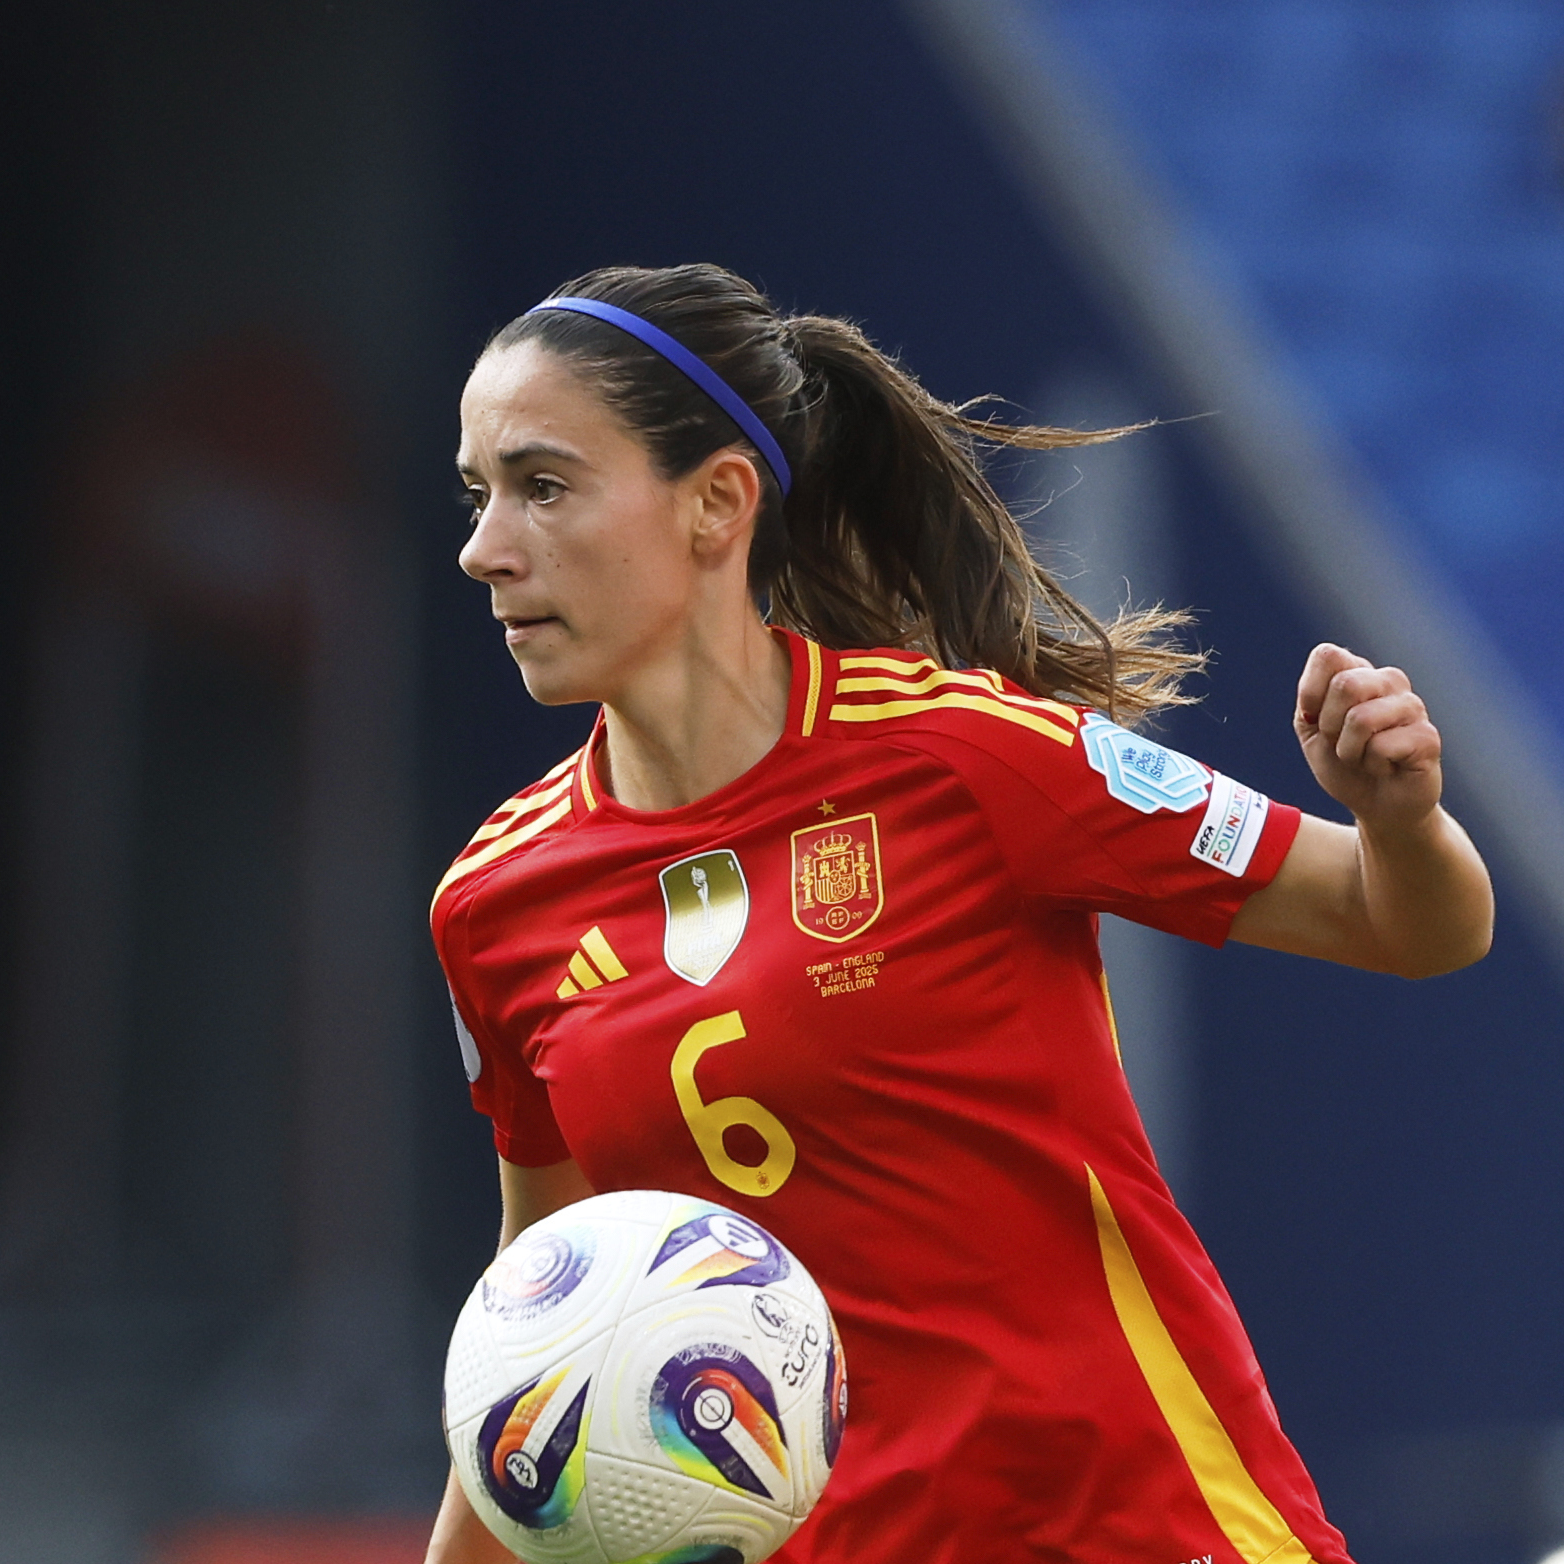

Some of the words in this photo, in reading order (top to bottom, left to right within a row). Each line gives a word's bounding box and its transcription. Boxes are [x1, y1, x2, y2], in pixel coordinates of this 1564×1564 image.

[1211, 785, 1247, 864] FOUNDATIO
[1196, 825, 1215, 855] UEFA
[806, 962, 832, 976] SPAIN
[842, 951, 885, 968] ENGLAND
[813, 976, 820, 987] 3
[826, 970, 850, 984] JUNE
[855, 964, 879, 978] 2025
[820, 977, 875, 997] BARCELONA
[670, 1009, 797, 1196] 6
